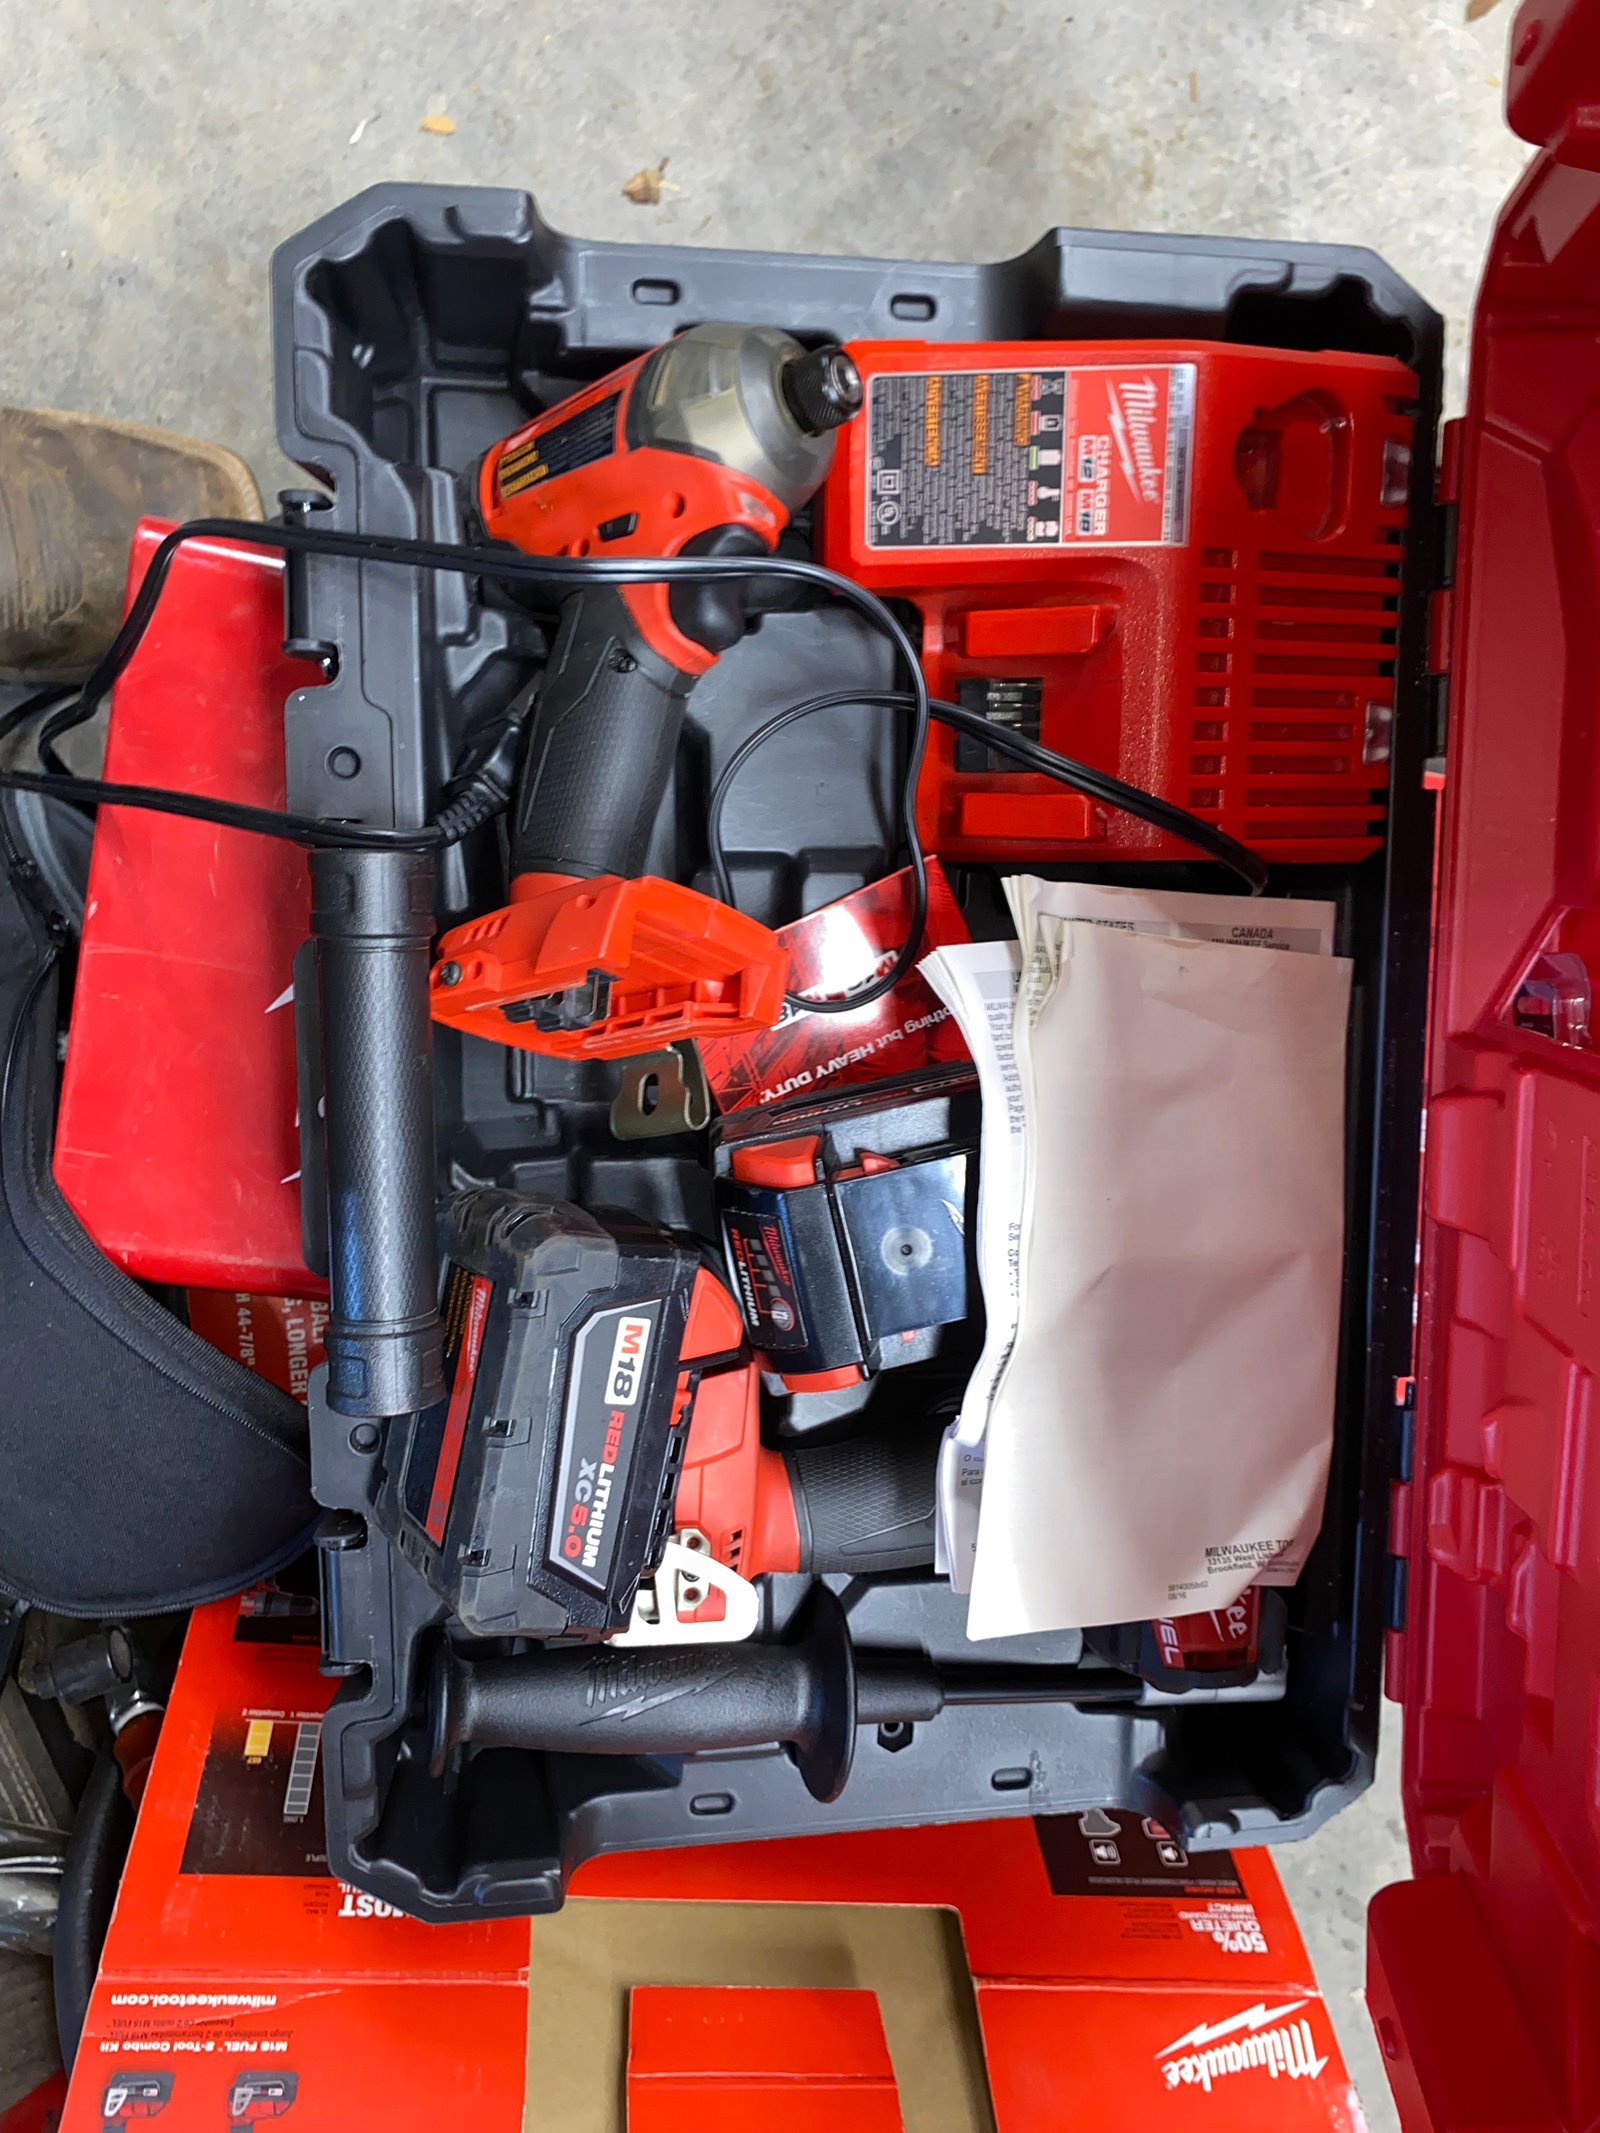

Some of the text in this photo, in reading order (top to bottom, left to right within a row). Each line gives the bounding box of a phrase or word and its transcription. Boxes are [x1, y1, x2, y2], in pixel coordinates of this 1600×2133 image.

[1118, 376, 1164, 502] Milwaukee
[1094, 435, 1110, 535] CHARGER
[1232, 927, 1273, 939] CANADA
[876, 1029, 903, 1048] but
[816, 1042, 875, 1079] HEAVY
[763, 1226, 791, 1286] Milwaukee
[730, 1227, 760, 1327] REDLITHIUM
[286, 1317, 308, 1395] LONGER
[613, 1324, 644, 1400] M18
[961, 1468, 980, 1476] Para
[581, 1410, 625, 1568] REDLITHIUM
[1205, 1540, 1274, 1557] MILWAUKEE
[1234, 1554, 1257, 1562] West
[1207, 1561, 1254, 1574] Brookfield,
[1207, 1903, 1254, 1913] IMPACT
[1190, 1919, 1261, 1932] QUIETER
[1212, 1932, 1269, 1954] 50%
[111, 1994, 277, 2008] milwaukeetool.com
[100, 2041, 119, 2053] Kit
[123, 2041, 170, 2052] Combo
[173, 2041, 215, 2052] 2-Tool
[261, 2041, 288, 2052] M18
[1161, 2018, 1329, 2092] Milwaukee
